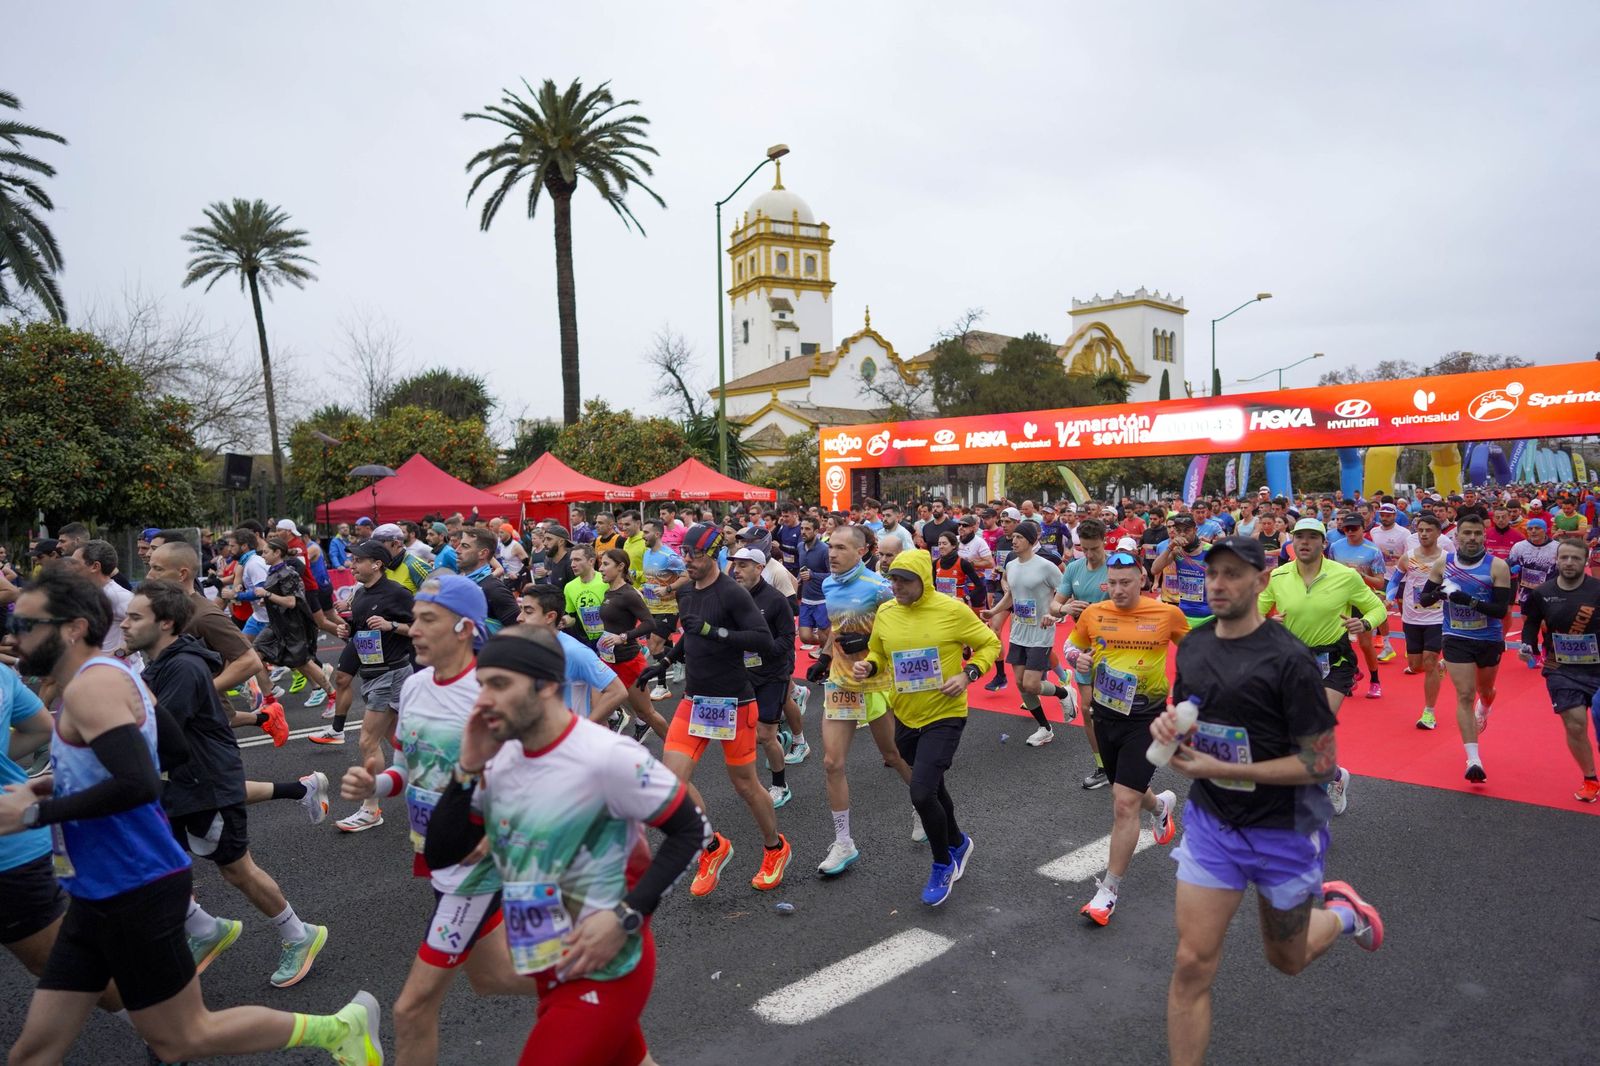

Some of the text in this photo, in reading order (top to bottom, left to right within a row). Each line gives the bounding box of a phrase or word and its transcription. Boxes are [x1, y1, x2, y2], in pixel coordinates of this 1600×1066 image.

[1249, 407, 1315, 430] HOKA
[1327, 417, 1379, 429] HYUNDAI
[965, 430, 1008, 448] HOKA
[1093, 427, 1150, 446] sevilla
[900, 659, 929, 674] 3249
[832, 692, 857, 704] 6796
[699, 706, 725, 721] 3284
